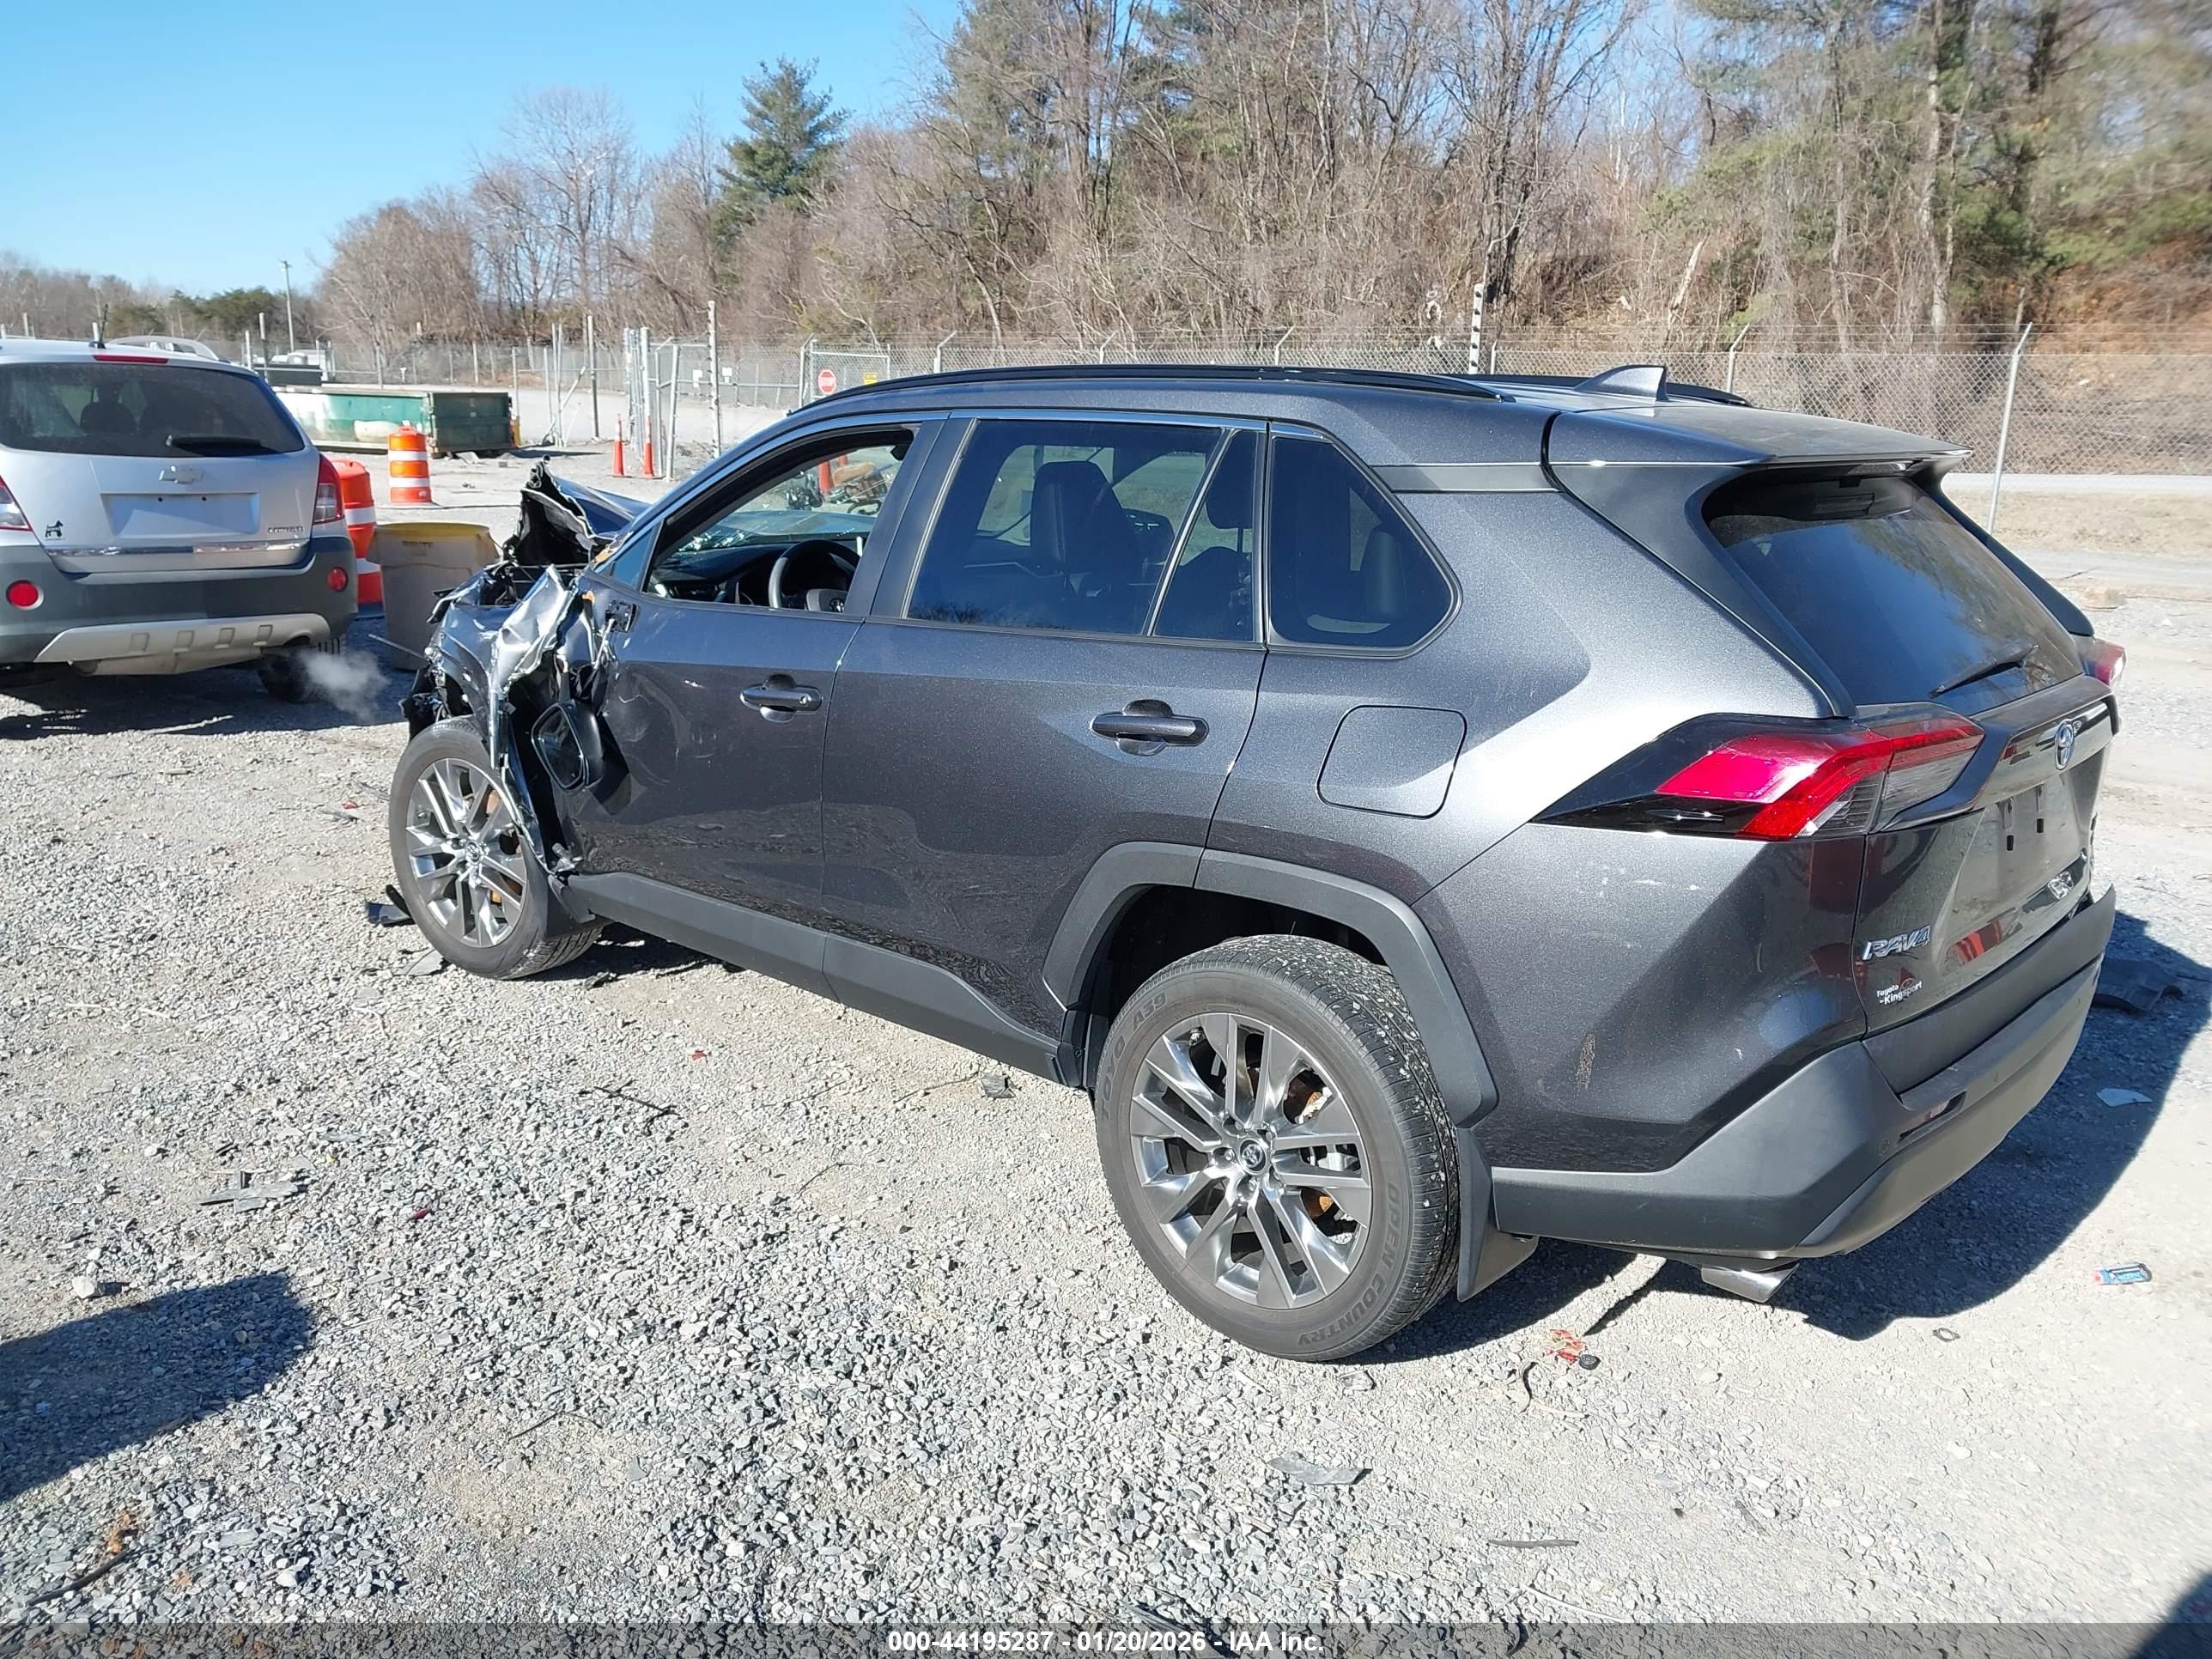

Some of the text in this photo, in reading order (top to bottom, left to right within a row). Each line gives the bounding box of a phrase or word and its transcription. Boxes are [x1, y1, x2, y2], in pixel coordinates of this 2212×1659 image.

[1863, 925, 1931, 960] RAV4
[1876, 984, 1899, 998] Toyota
[1102, 1035, 1126, 1120] TOYO
[1297, 1182, 1402, 1346] OPEN COUNTRY
